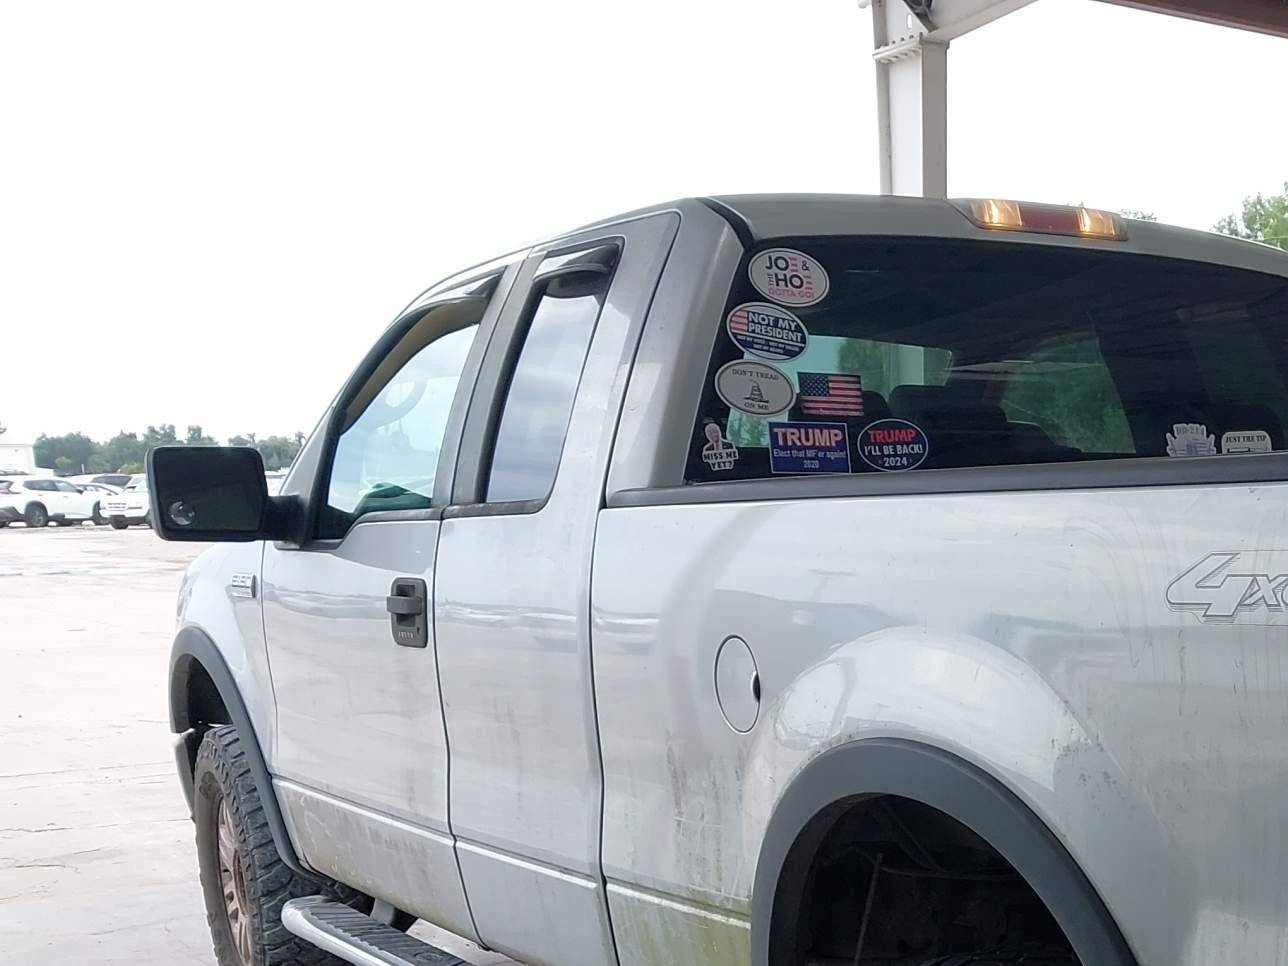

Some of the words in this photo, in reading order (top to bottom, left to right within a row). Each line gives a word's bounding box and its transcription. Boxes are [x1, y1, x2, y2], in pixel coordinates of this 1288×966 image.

[765, 255, 799, 272] JOE
[801, 260, 810, 271] &
[775, 273, 813, 290] HOE
[748, 312, 775, 326] NOT
[778, 318, 797, 331] MY
[748, 322, 803, 342] PRESIDENT
[773, 428, 843, 446] TRUMP
[867, 428, 917, 443] TRUMP
[1225, 436, 1243, 444] JUST
[703, 451, 723, 460] MISS
[864, 445, 882, 456] I'LL
[882, 445, 895, 455] BE
[896, 443, 924, 454] BACK!
[711, 460, 732, 470] YET?
[883, 456, 908, 467] 2024
